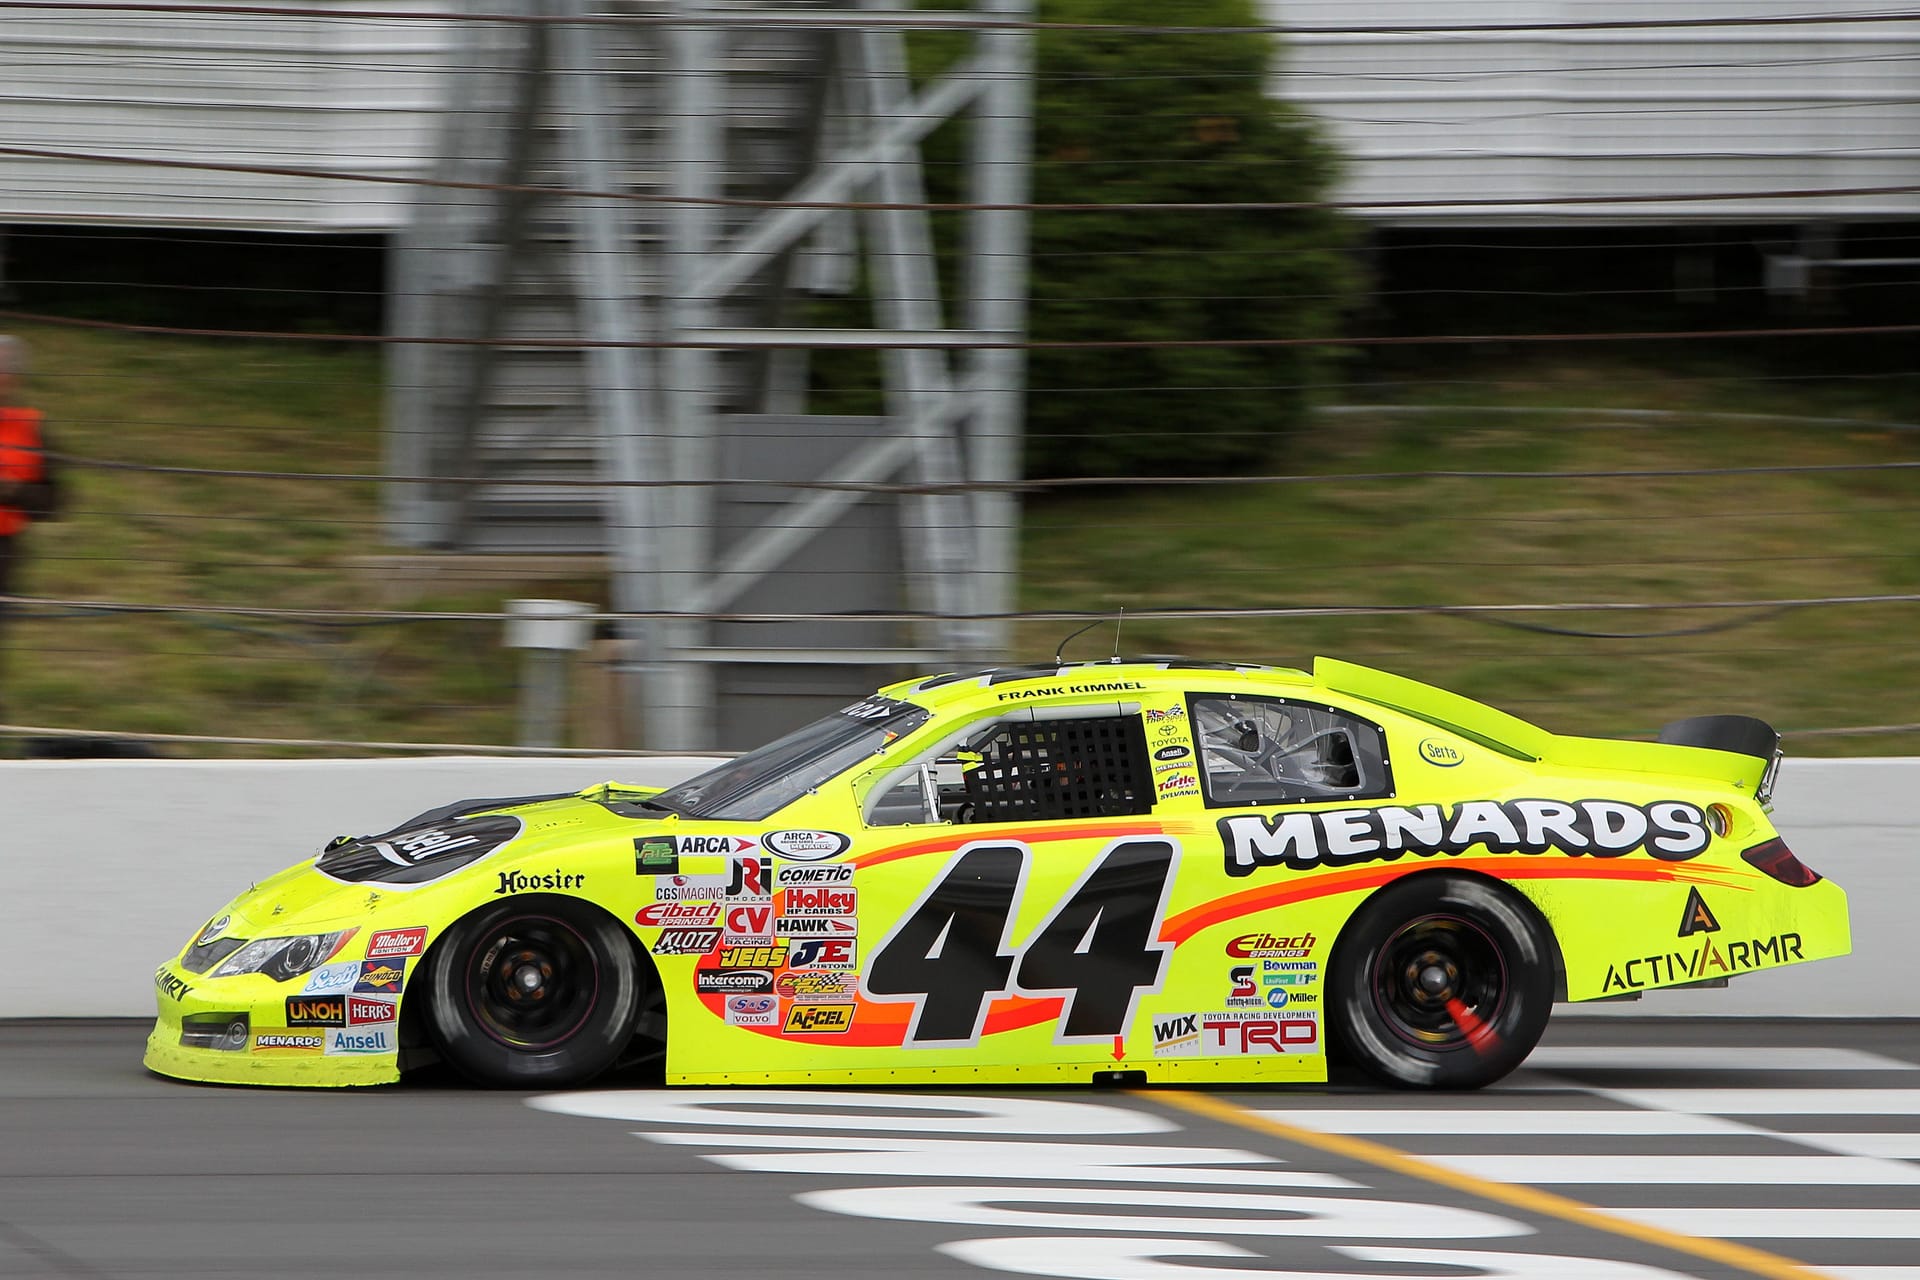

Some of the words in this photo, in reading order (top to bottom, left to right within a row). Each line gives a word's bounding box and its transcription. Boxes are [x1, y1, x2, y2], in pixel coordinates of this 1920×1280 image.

[998, 687, 1065, 701] FRANK
[1070, 682, 1147, 694] KIMMEL
[1151, 736, 1189, 748] TOYOTA
[1427, 743, 1458, 759] Serta
[1155, 761, 1194, 772] MENARDS
[1158, 775, 1196, 792] Turtle
[1160, 789, 1199, 800] SYLVANIA
[783, 832, 813, 840] ARCA
[1221, 799, 1711, 876] MENARDS
[680, 837, 730, 853] ARCA
[494, 868, 585, 894] Hoosier
[779, 865, 852, 881] COMETIC
[786, 889, 855, 914] Holley
[635, 902, 721, 926] Eibach
[657, 917, 709, 926] SPRINGS
[727, 907, 771, 934] CV
[776, 919, 829, 932] HAWK
[376, 933, 421, 950] Mallory
[661, 931, 718, 949] KLOTZ
[860, 836, 1181, 1047] 44
[1225, 932, 1317, 958] Eibach
[720, 947, 788, 968] JEGS
[790, 940, 852, 968] JE
[1249, 949, 1305, 958] SPRINGS
[1263, 960, 1317, 970] Bowman
[1602, 932, 1805, 993] ACTIVARMR
[304, 963, 358, 992] Scott
[361, 970, 403, 982] SUNOCO
[698, 973, 765, 988] Intercomp
[780, 977, 822, 986] FAST
[794, 983, 848, 993] TRACK
[1289, 993, 1318, 1002] Miller
[289, 1002, 342, 1020] UNOH
[353, 1004, 391, 1019] HERR'S
[735, 1015, 769, 1023] VOLVO
[791, 1008, 845, 1029] ACCEL
[1233, 1012, 1262, 1020] RACING
[1262, 1011, 1316, 1019] DEVELOPMENT
[1153, 1014, 1198, 1042] WIX
[256, 1035, 322, 1047] MENARDS
[335, 1031, 387, 1049] Ansell
[1203, 1020, 1317, 1053] TRD
